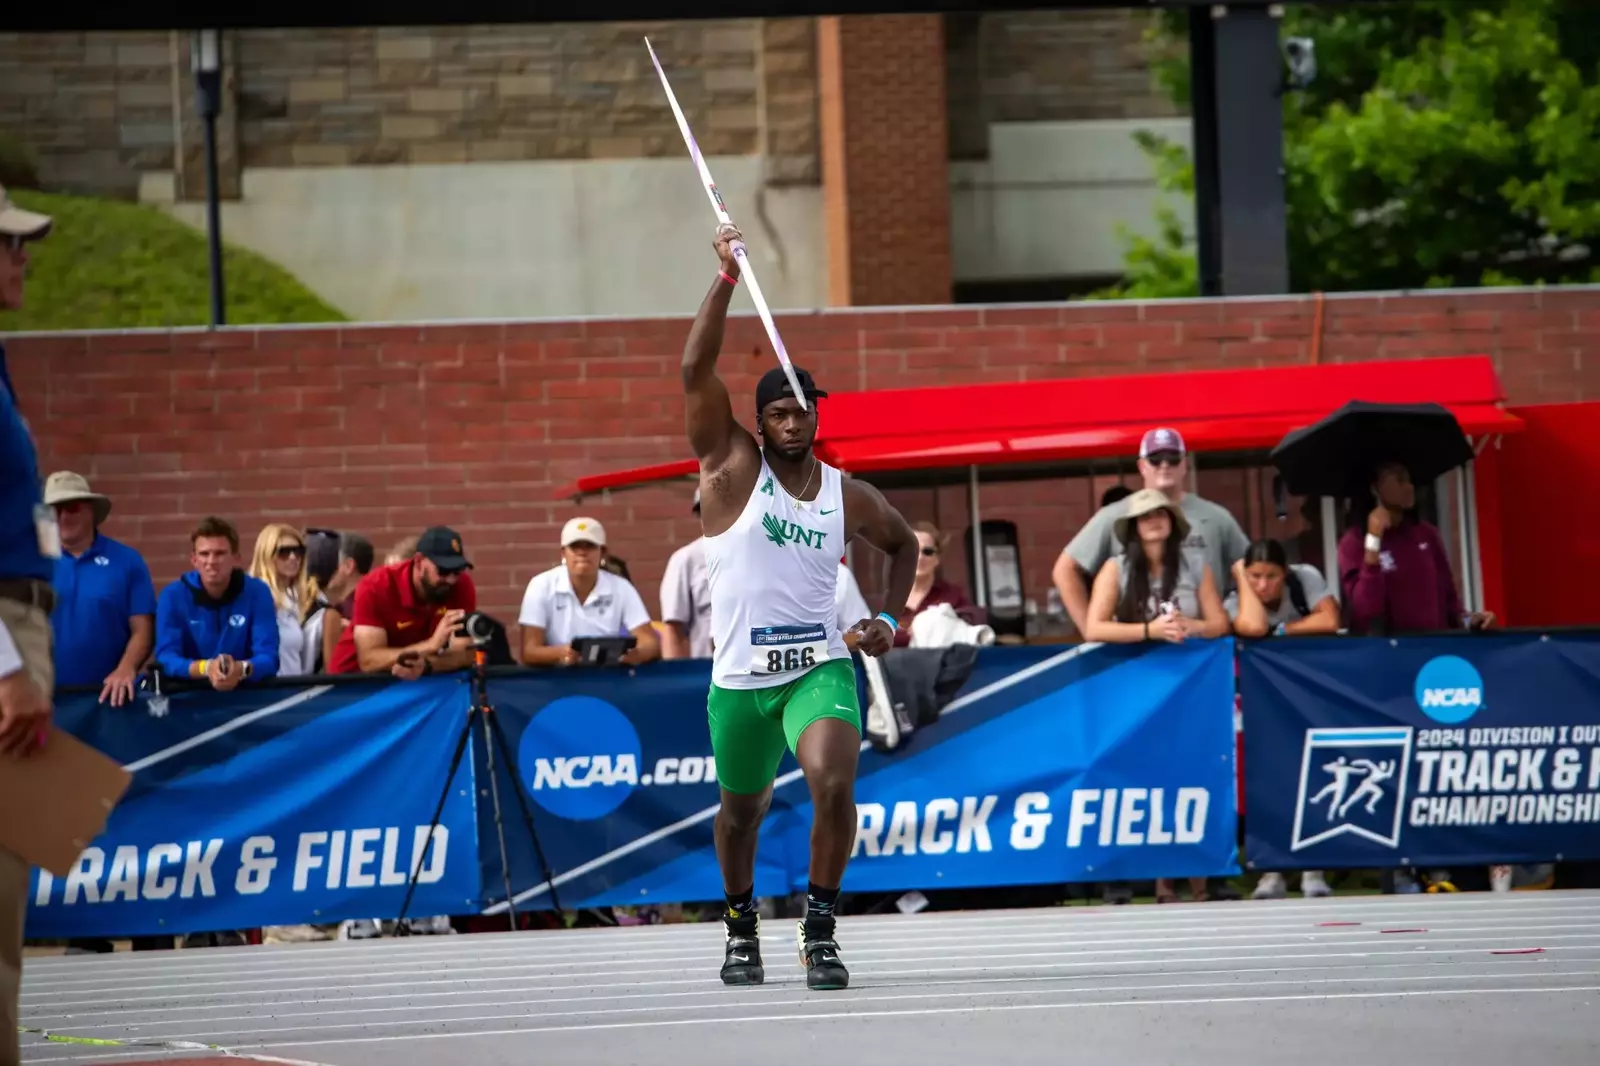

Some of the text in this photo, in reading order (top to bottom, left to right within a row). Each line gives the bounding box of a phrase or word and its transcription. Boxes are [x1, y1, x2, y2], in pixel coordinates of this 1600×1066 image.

[780, 518, 828, 550] UNT
[767, 646, 816, 672] 866
[1422, 687, 1482, 708] NCAA
[1417, 725, 1600, 747] 2024 DIVISION I OU
[1416, 749, 1547, 793] TRACK
[1551, 747, 1582, 790] &
[849, 787, 1210, 859] RACK & FIELD
[235, 835, 277, 895] &
[293, 823, 450, 891] FIELD
